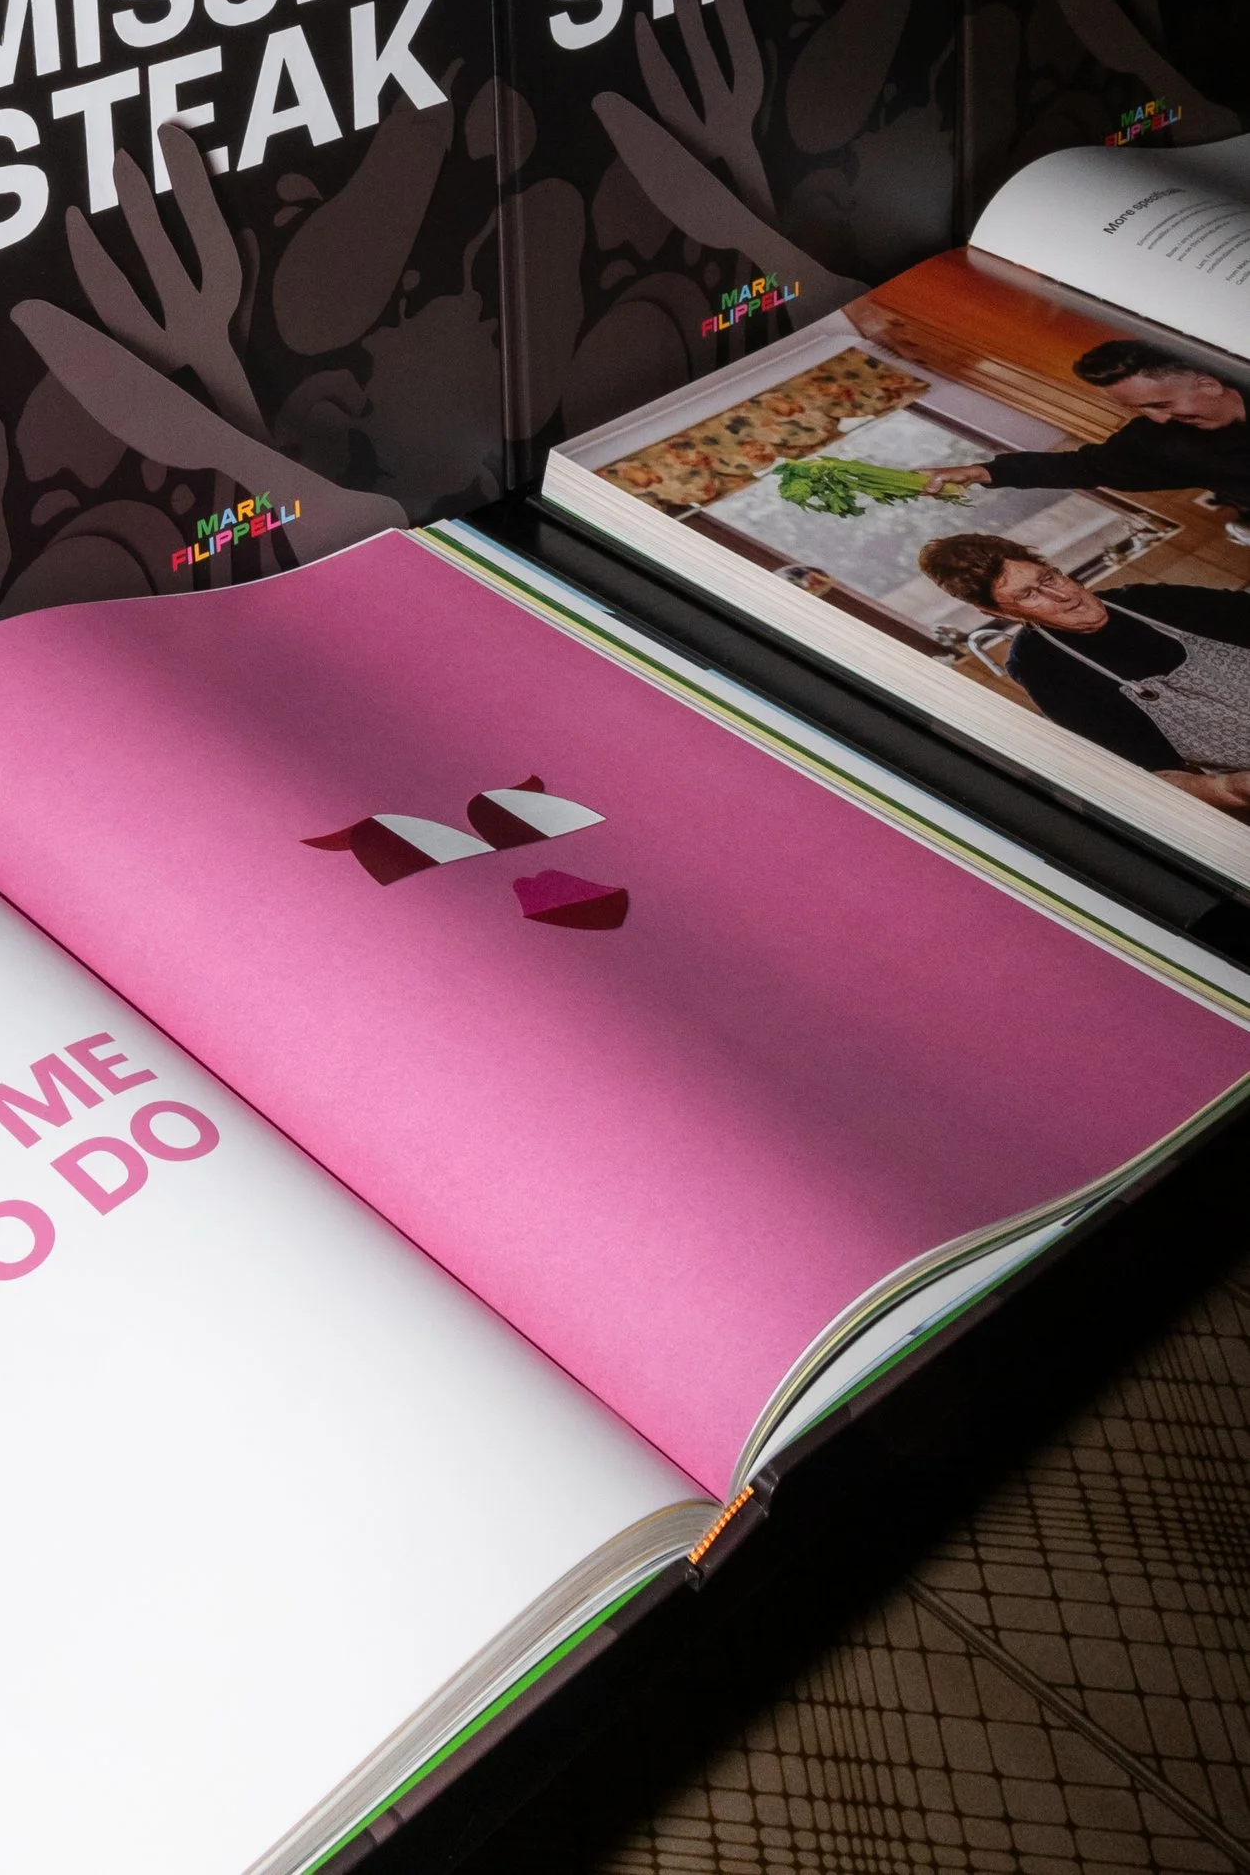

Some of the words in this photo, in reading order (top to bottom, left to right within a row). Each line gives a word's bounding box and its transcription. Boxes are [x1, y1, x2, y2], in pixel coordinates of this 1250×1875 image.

[1103, 207, 1136, 235] More
[701, 280, 800, 338] FILIPPELLI
[721, 272, 780, 310] MARK
[171, 499, 300, 572] FILIPPELLI
[197, 491, 273, 538] MARK
[50, 1100, 220, 1217] DO
